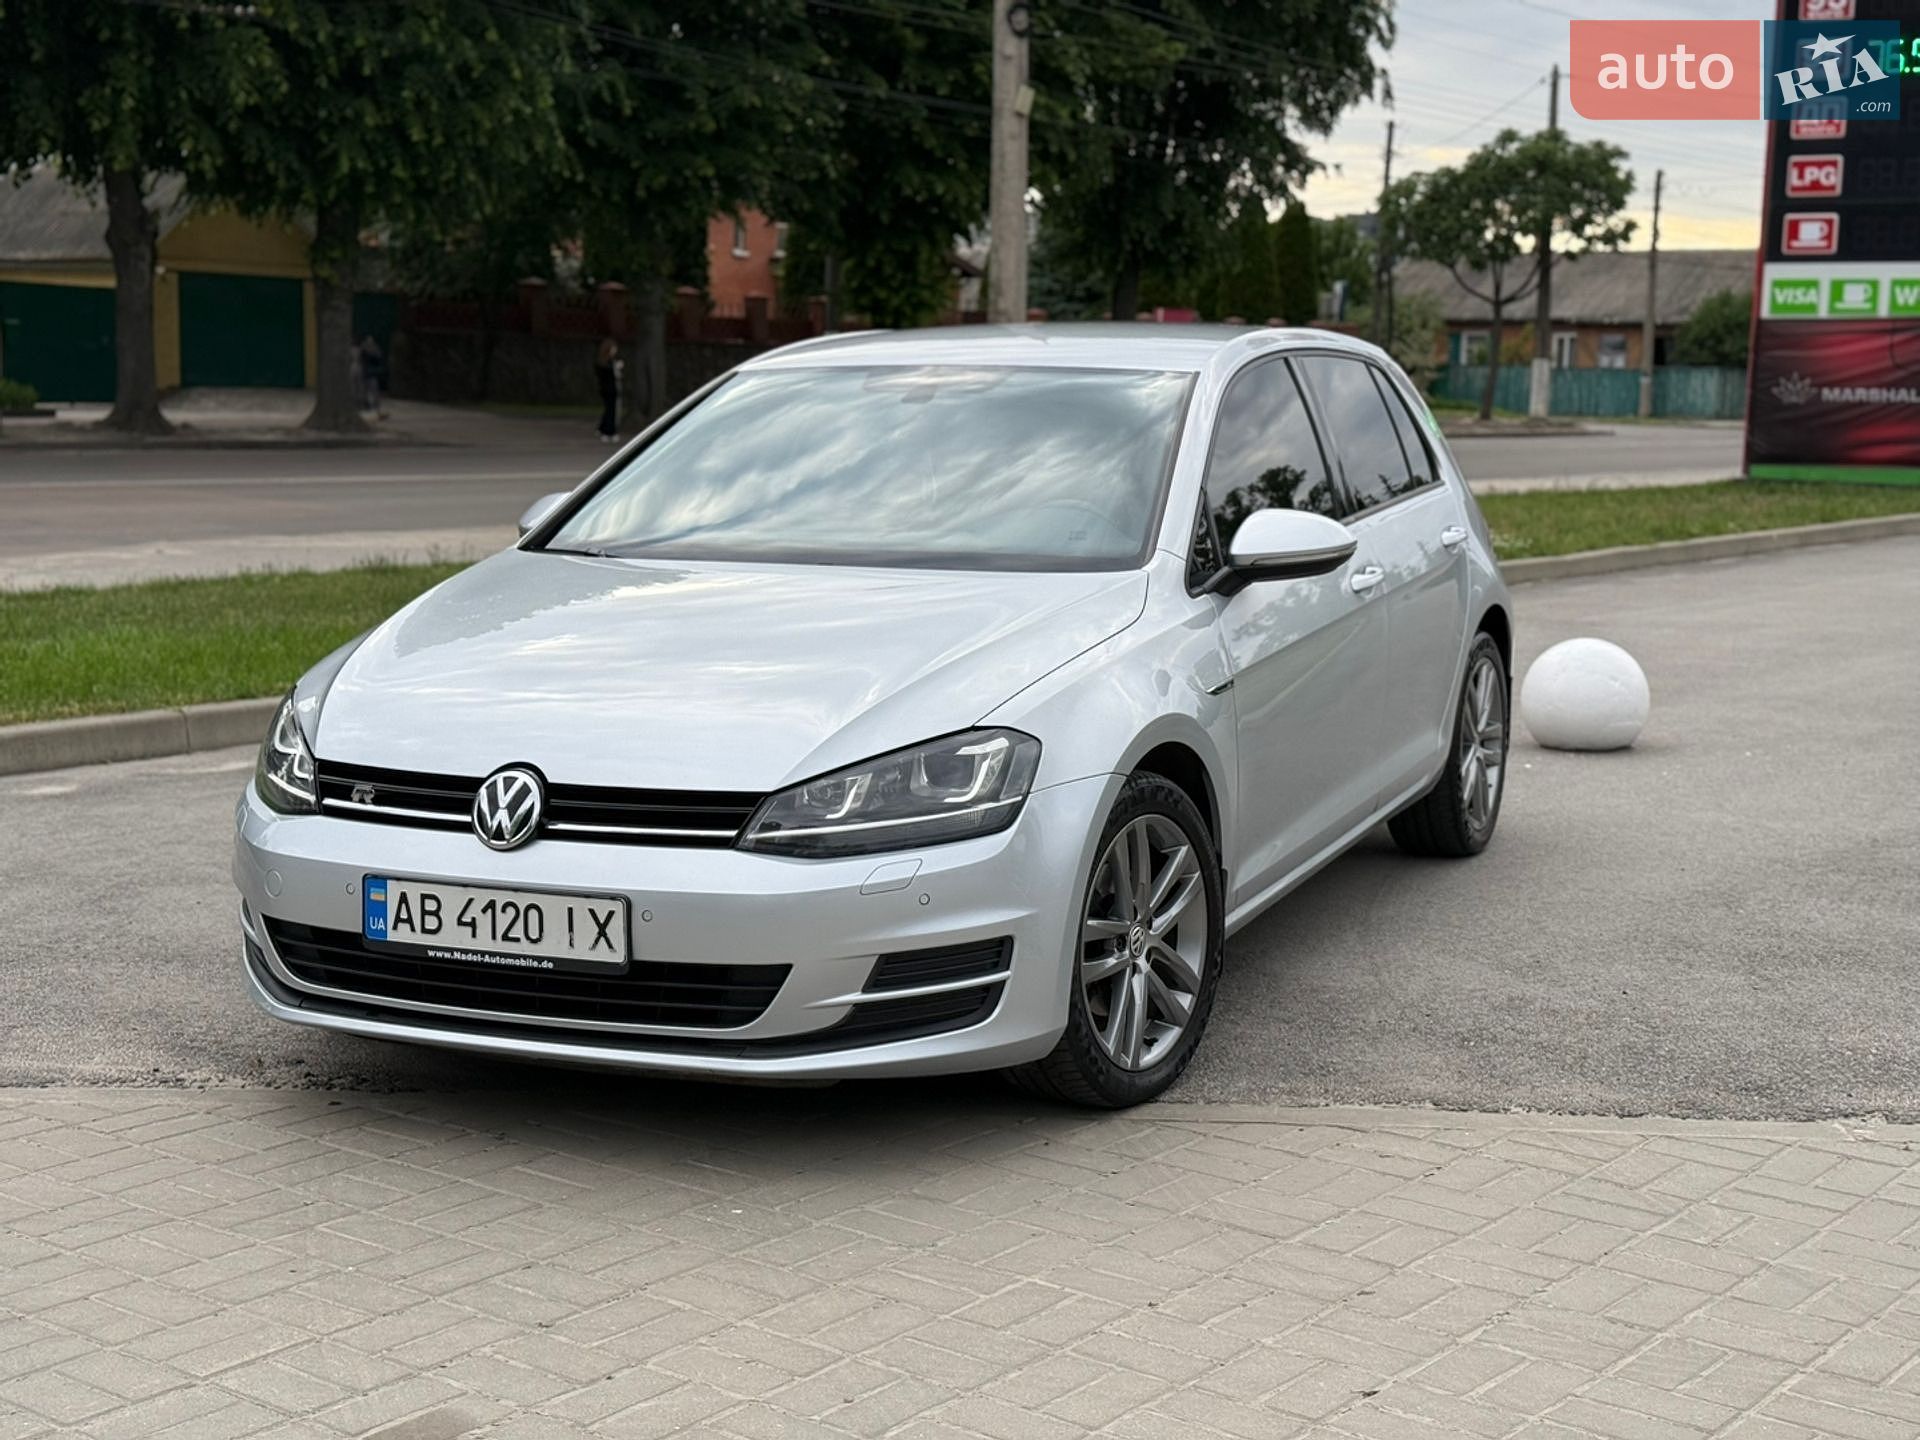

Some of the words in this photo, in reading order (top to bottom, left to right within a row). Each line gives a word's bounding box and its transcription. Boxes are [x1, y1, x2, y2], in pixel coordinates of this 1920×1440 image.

[1791, 166, 1836, 187] LPG
[1774, 286, 1818, 305] VISA
[369, 916, 386, 930] UA
[391, 890, 443, 935] AB
[456, 897, 544, 944] 4120
